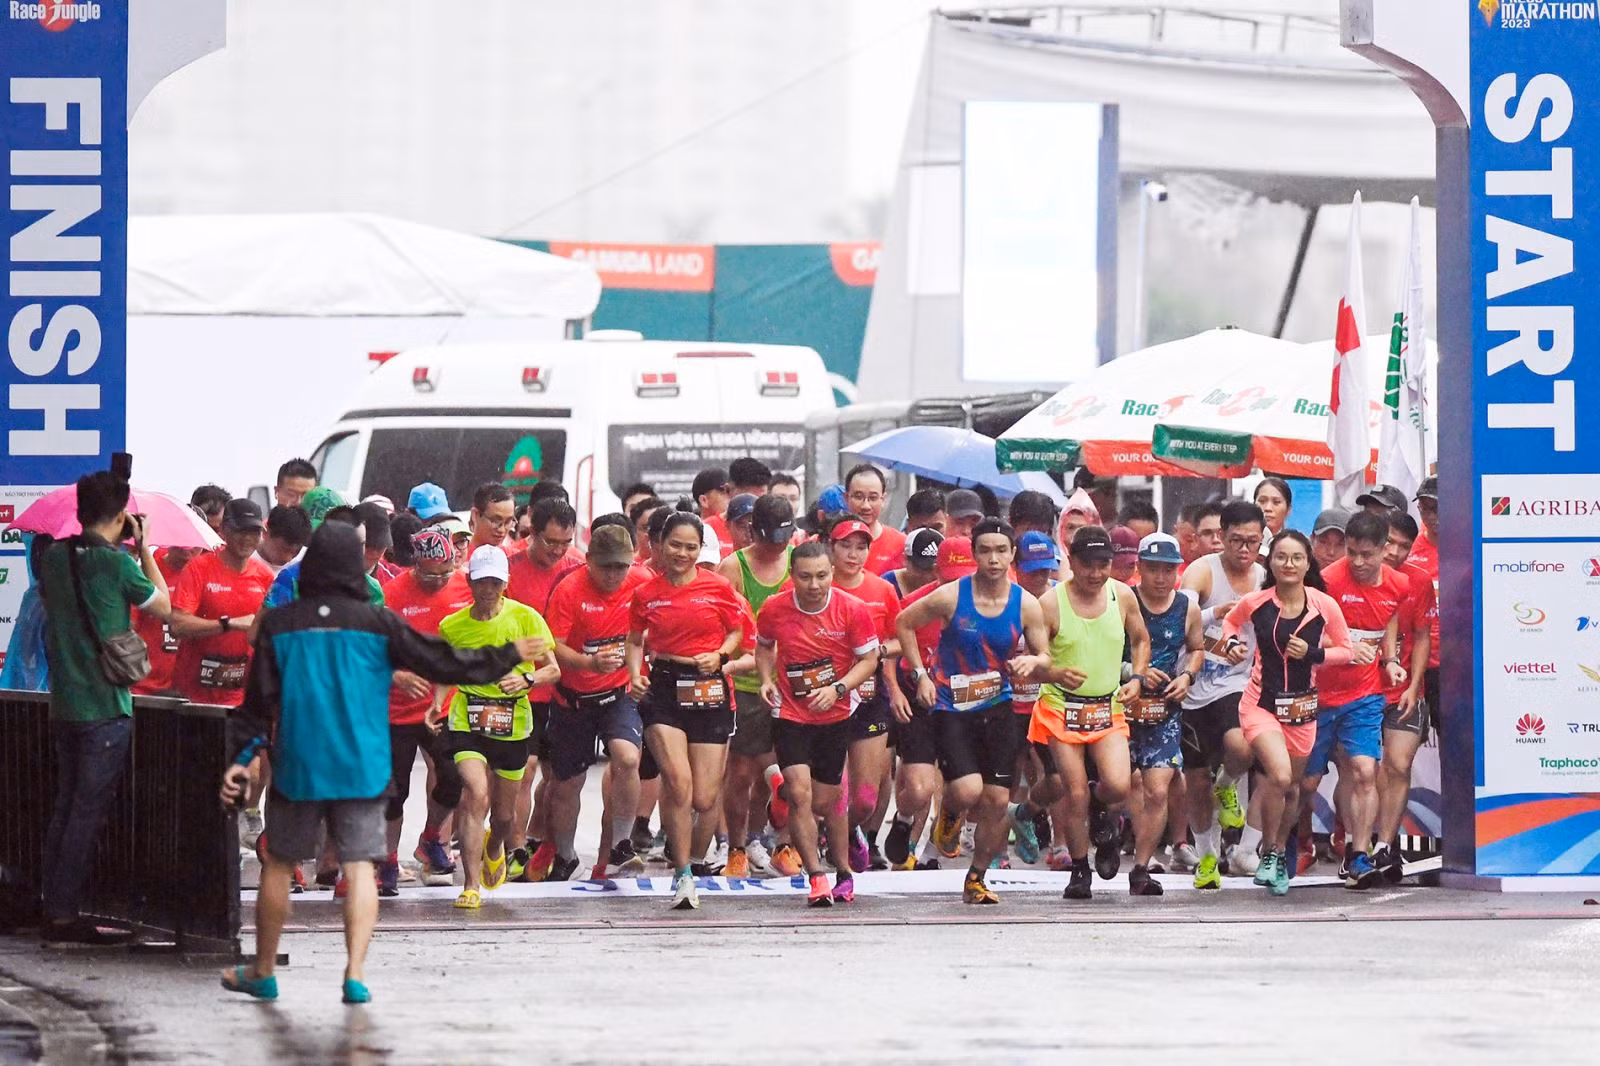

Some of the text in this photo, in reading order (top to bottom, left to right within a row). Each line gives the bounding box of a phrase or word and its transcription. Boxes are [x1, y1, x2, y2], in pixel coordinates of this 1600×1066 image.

[10, 1, 46, 19] Race
[1501, 3, 1594, 19] MARATHON
[1501, 20, 1530, 28] 2023
[9, 77, 101, 456] FINISH
[1484, 72, 1575, 451] START
[1112, 453, 1141, 462] YOUR
[1283, 453, 1334, 466] YOUR ONL
[1493, 560, 1565, 573] mobifone
[1503, 662, 1557, 673] viettel
[469, 713, 479, 723] BC
[1066, 711, 1078, 720] BC
[1277, 707, 1288, 716] BC
[1539, 757, 1598, 770] Traphaco
